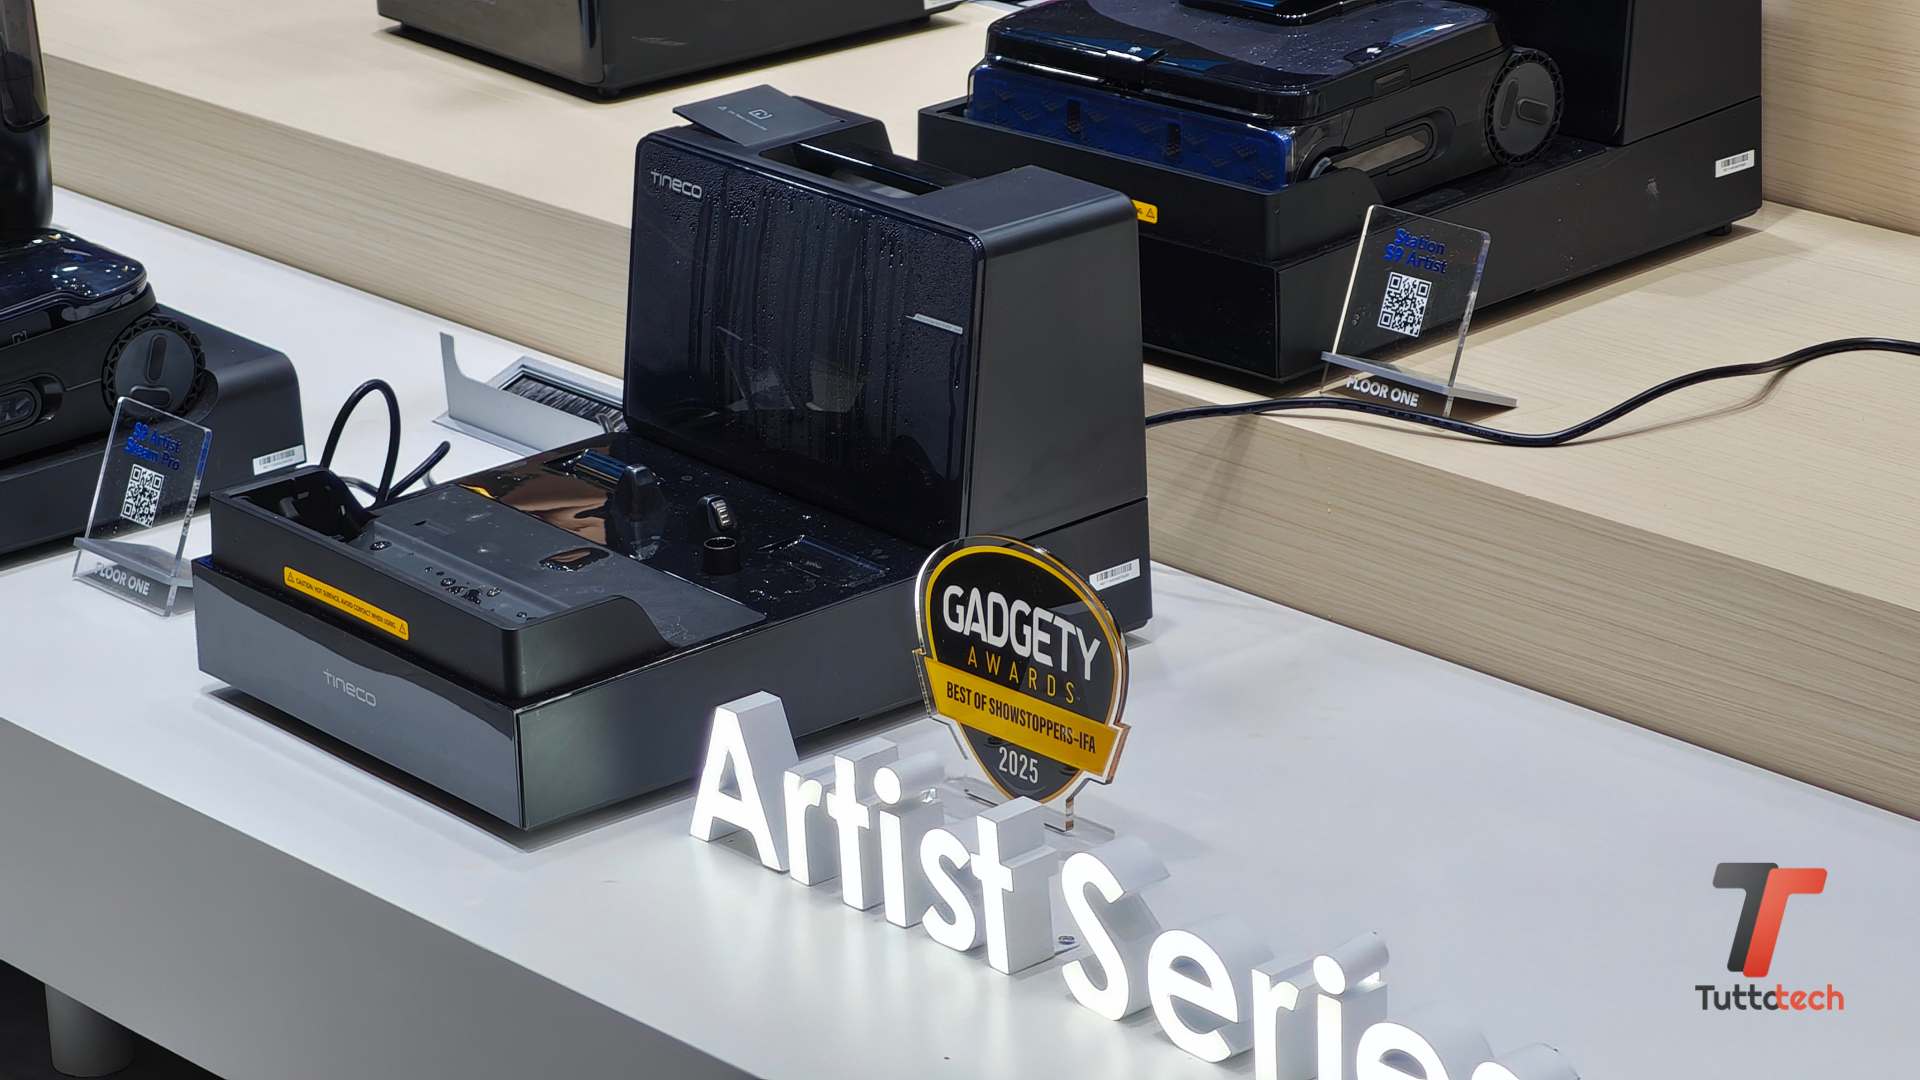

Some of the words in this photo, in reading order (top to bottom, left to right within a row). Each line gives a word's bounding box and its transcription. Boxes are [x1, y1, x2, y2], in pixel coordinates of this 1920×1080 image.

[1395, 228, 1445, 255] Station
[1383, 243, 1405, 262] S9
[1407, 251, 1448, 274] Artist
[1346, 375, 1389, 399] FLOOR
[1390, 388, 1420, 407] ONE
[151, 430, 181, 453] Artist
[161, 453, 180, 471] Pro
[93, 562, 127, 586] FLOOR
[128, 575, 150, 596] ONE
[943, 585, 1101, 681] GADGETY
[967, 646, 1076, 704] AWARDS
[946, 681, 973, 706] BEST
[974, 692, 987, 711] OF
[999, 746, 1039, 784] 2025
[690, 703, 1018, 976] Artist
[1062, 853, 1519, 1080] Serie
